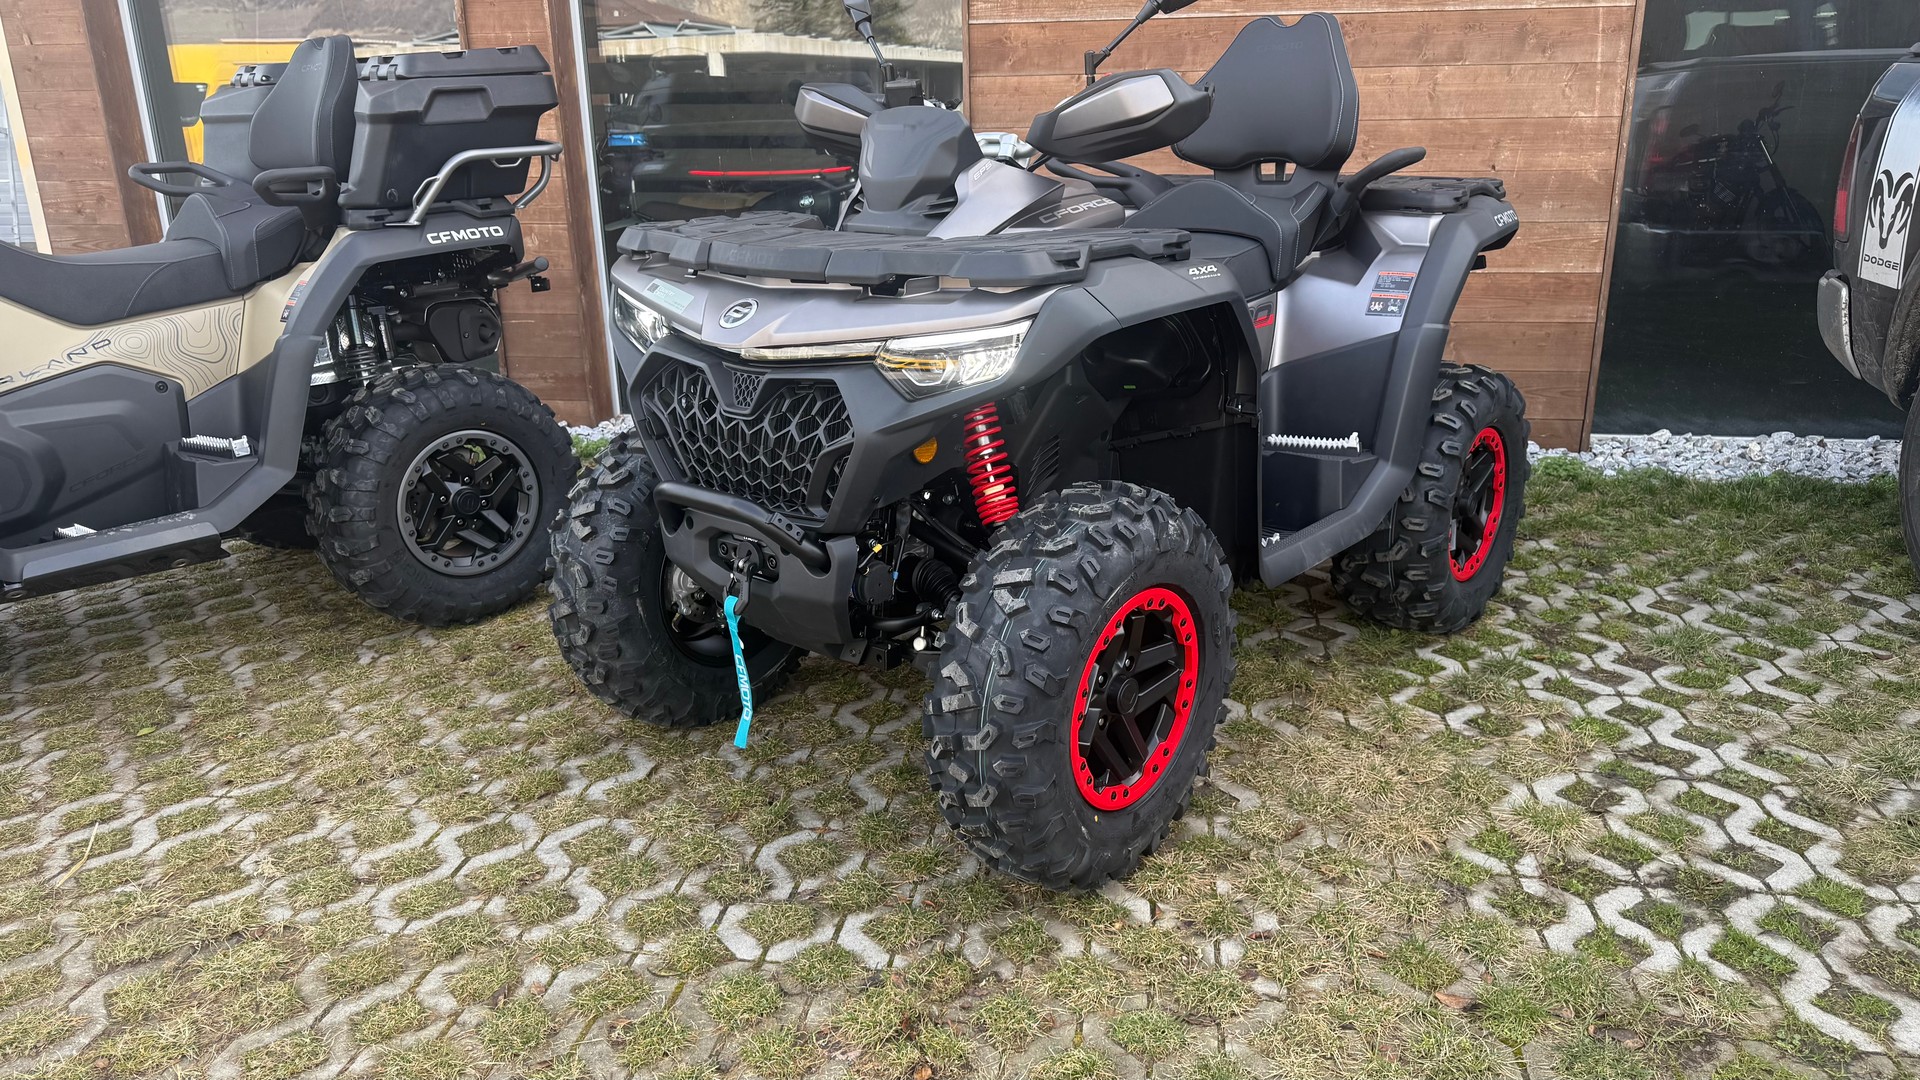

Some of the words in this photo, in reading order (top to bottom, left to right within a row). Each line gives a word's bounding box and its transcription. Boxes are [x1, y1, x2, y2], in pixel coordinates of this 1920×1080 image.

[973, 160, 993, 181] EPS
[1038, 197, 1117, 224] CFORCE
[1493, 209, 1519, 227] CFMOTO
[426, 225, 504, 245] CFMOTO
[1863, 253, 1900, 271] DODGE
[735, 653, 752, 721] CFMOTO
